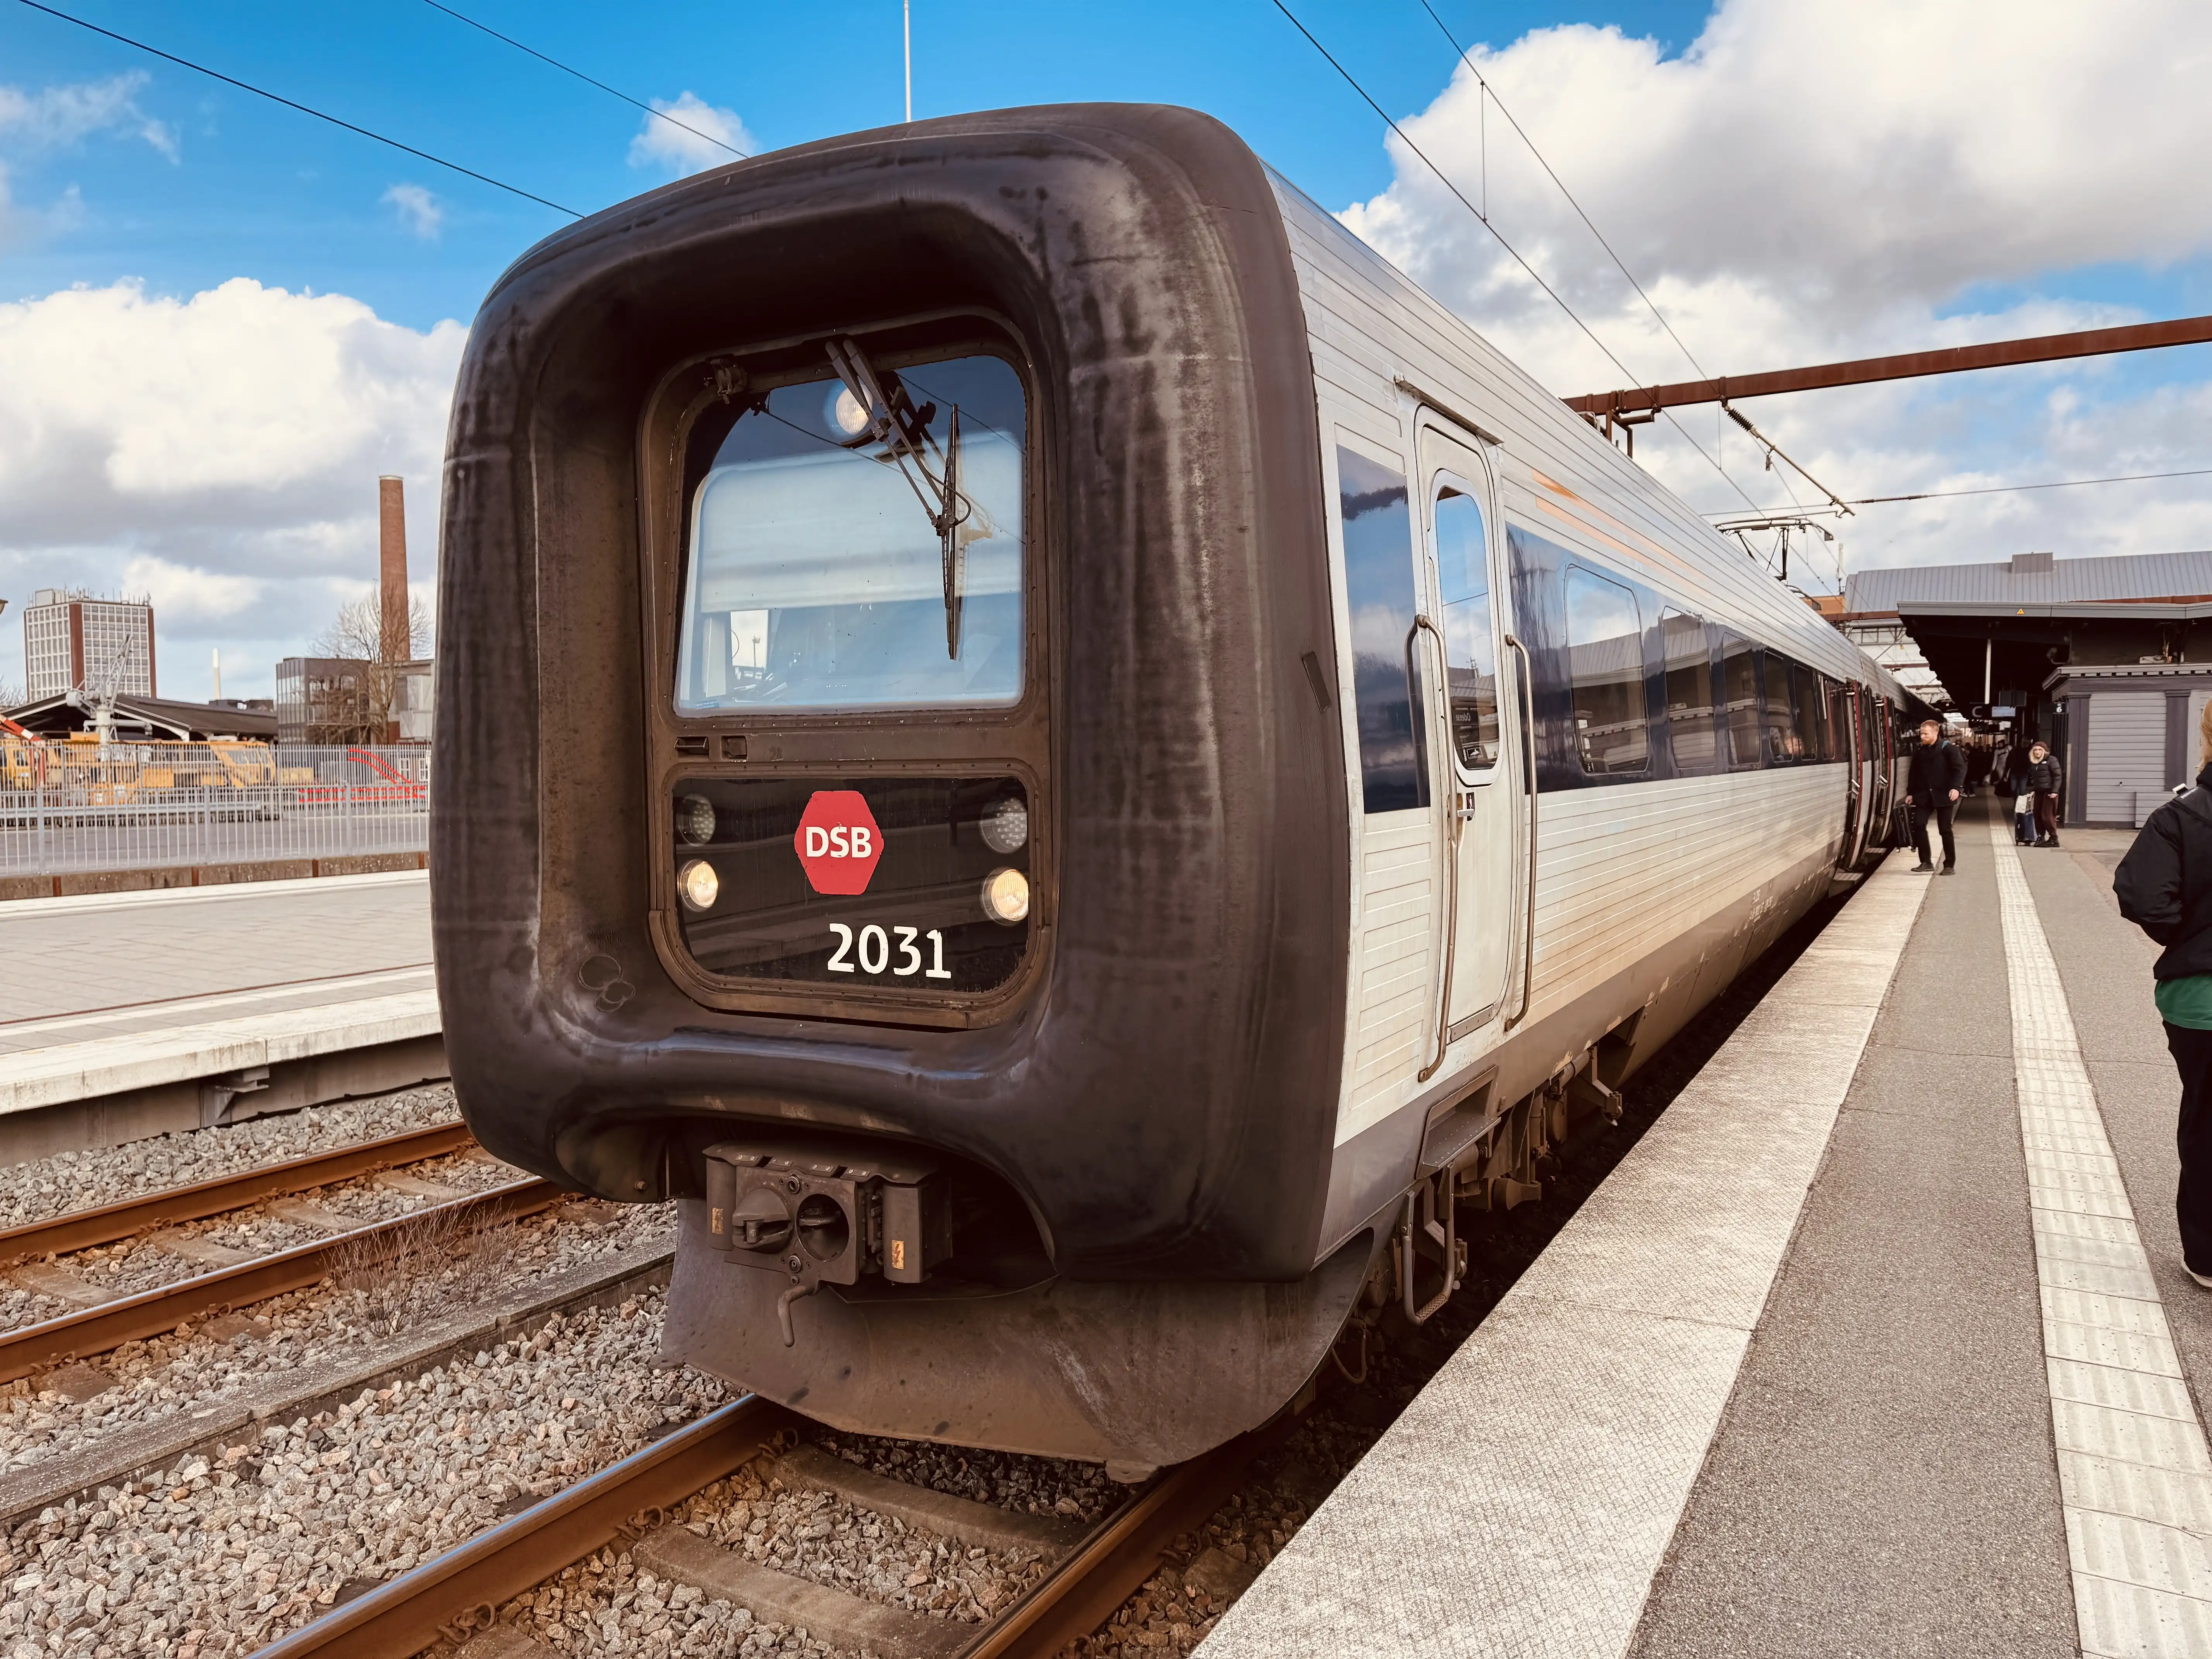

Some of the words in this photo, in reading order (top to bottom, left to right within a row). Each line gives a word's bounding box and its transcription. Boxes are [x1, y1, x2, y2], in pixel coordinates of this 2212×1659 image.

[1972, 706, 1982, 718] C
[805, 826, 872, 858] DSB
[828, 923, 951, 979] 2031
